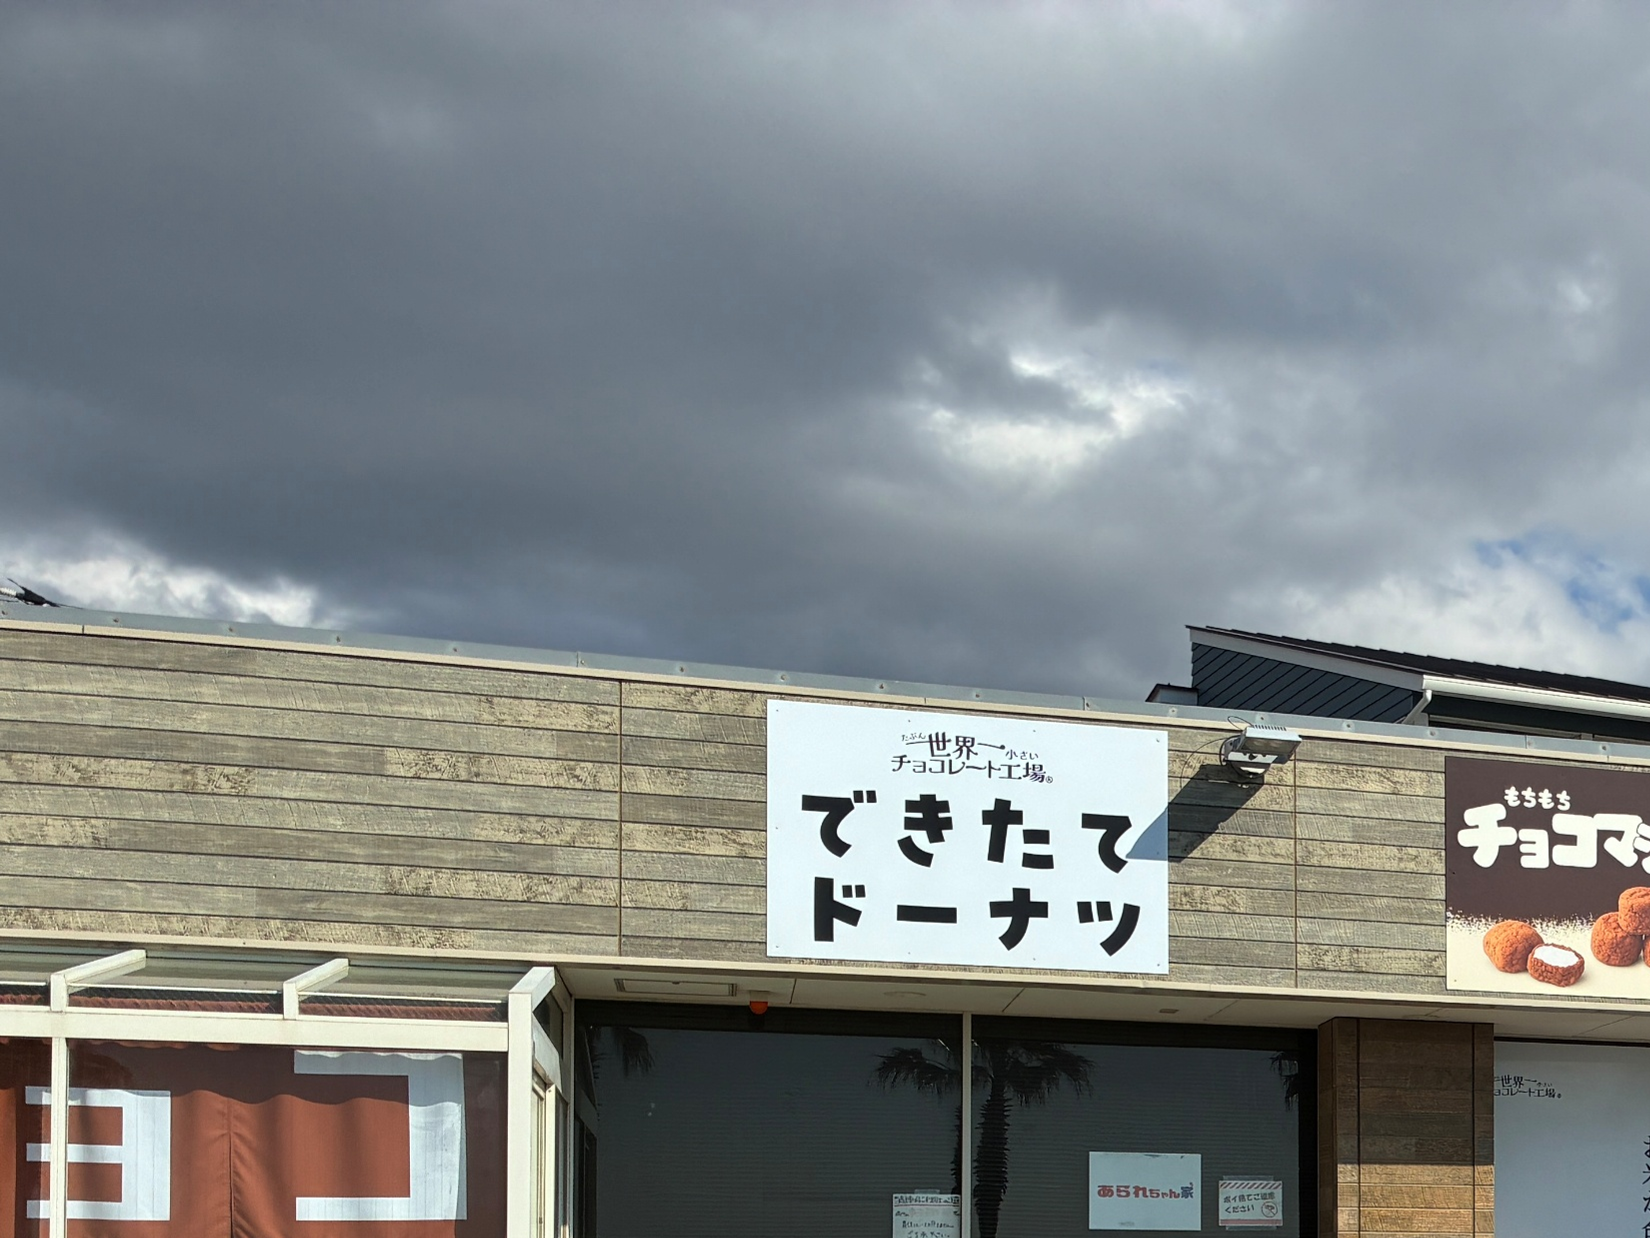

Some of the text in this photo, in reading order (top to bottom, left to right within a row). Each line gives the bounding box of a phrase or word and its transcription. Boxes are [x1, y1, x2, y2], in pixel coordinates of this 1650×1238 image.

[1504, 785, 1571, 811] もちもち
[802, 790, 1132, 873] できたて
[814, 876, 1140, 956] ドーナツ
[1225, 1204, 1255, 1214] ください
